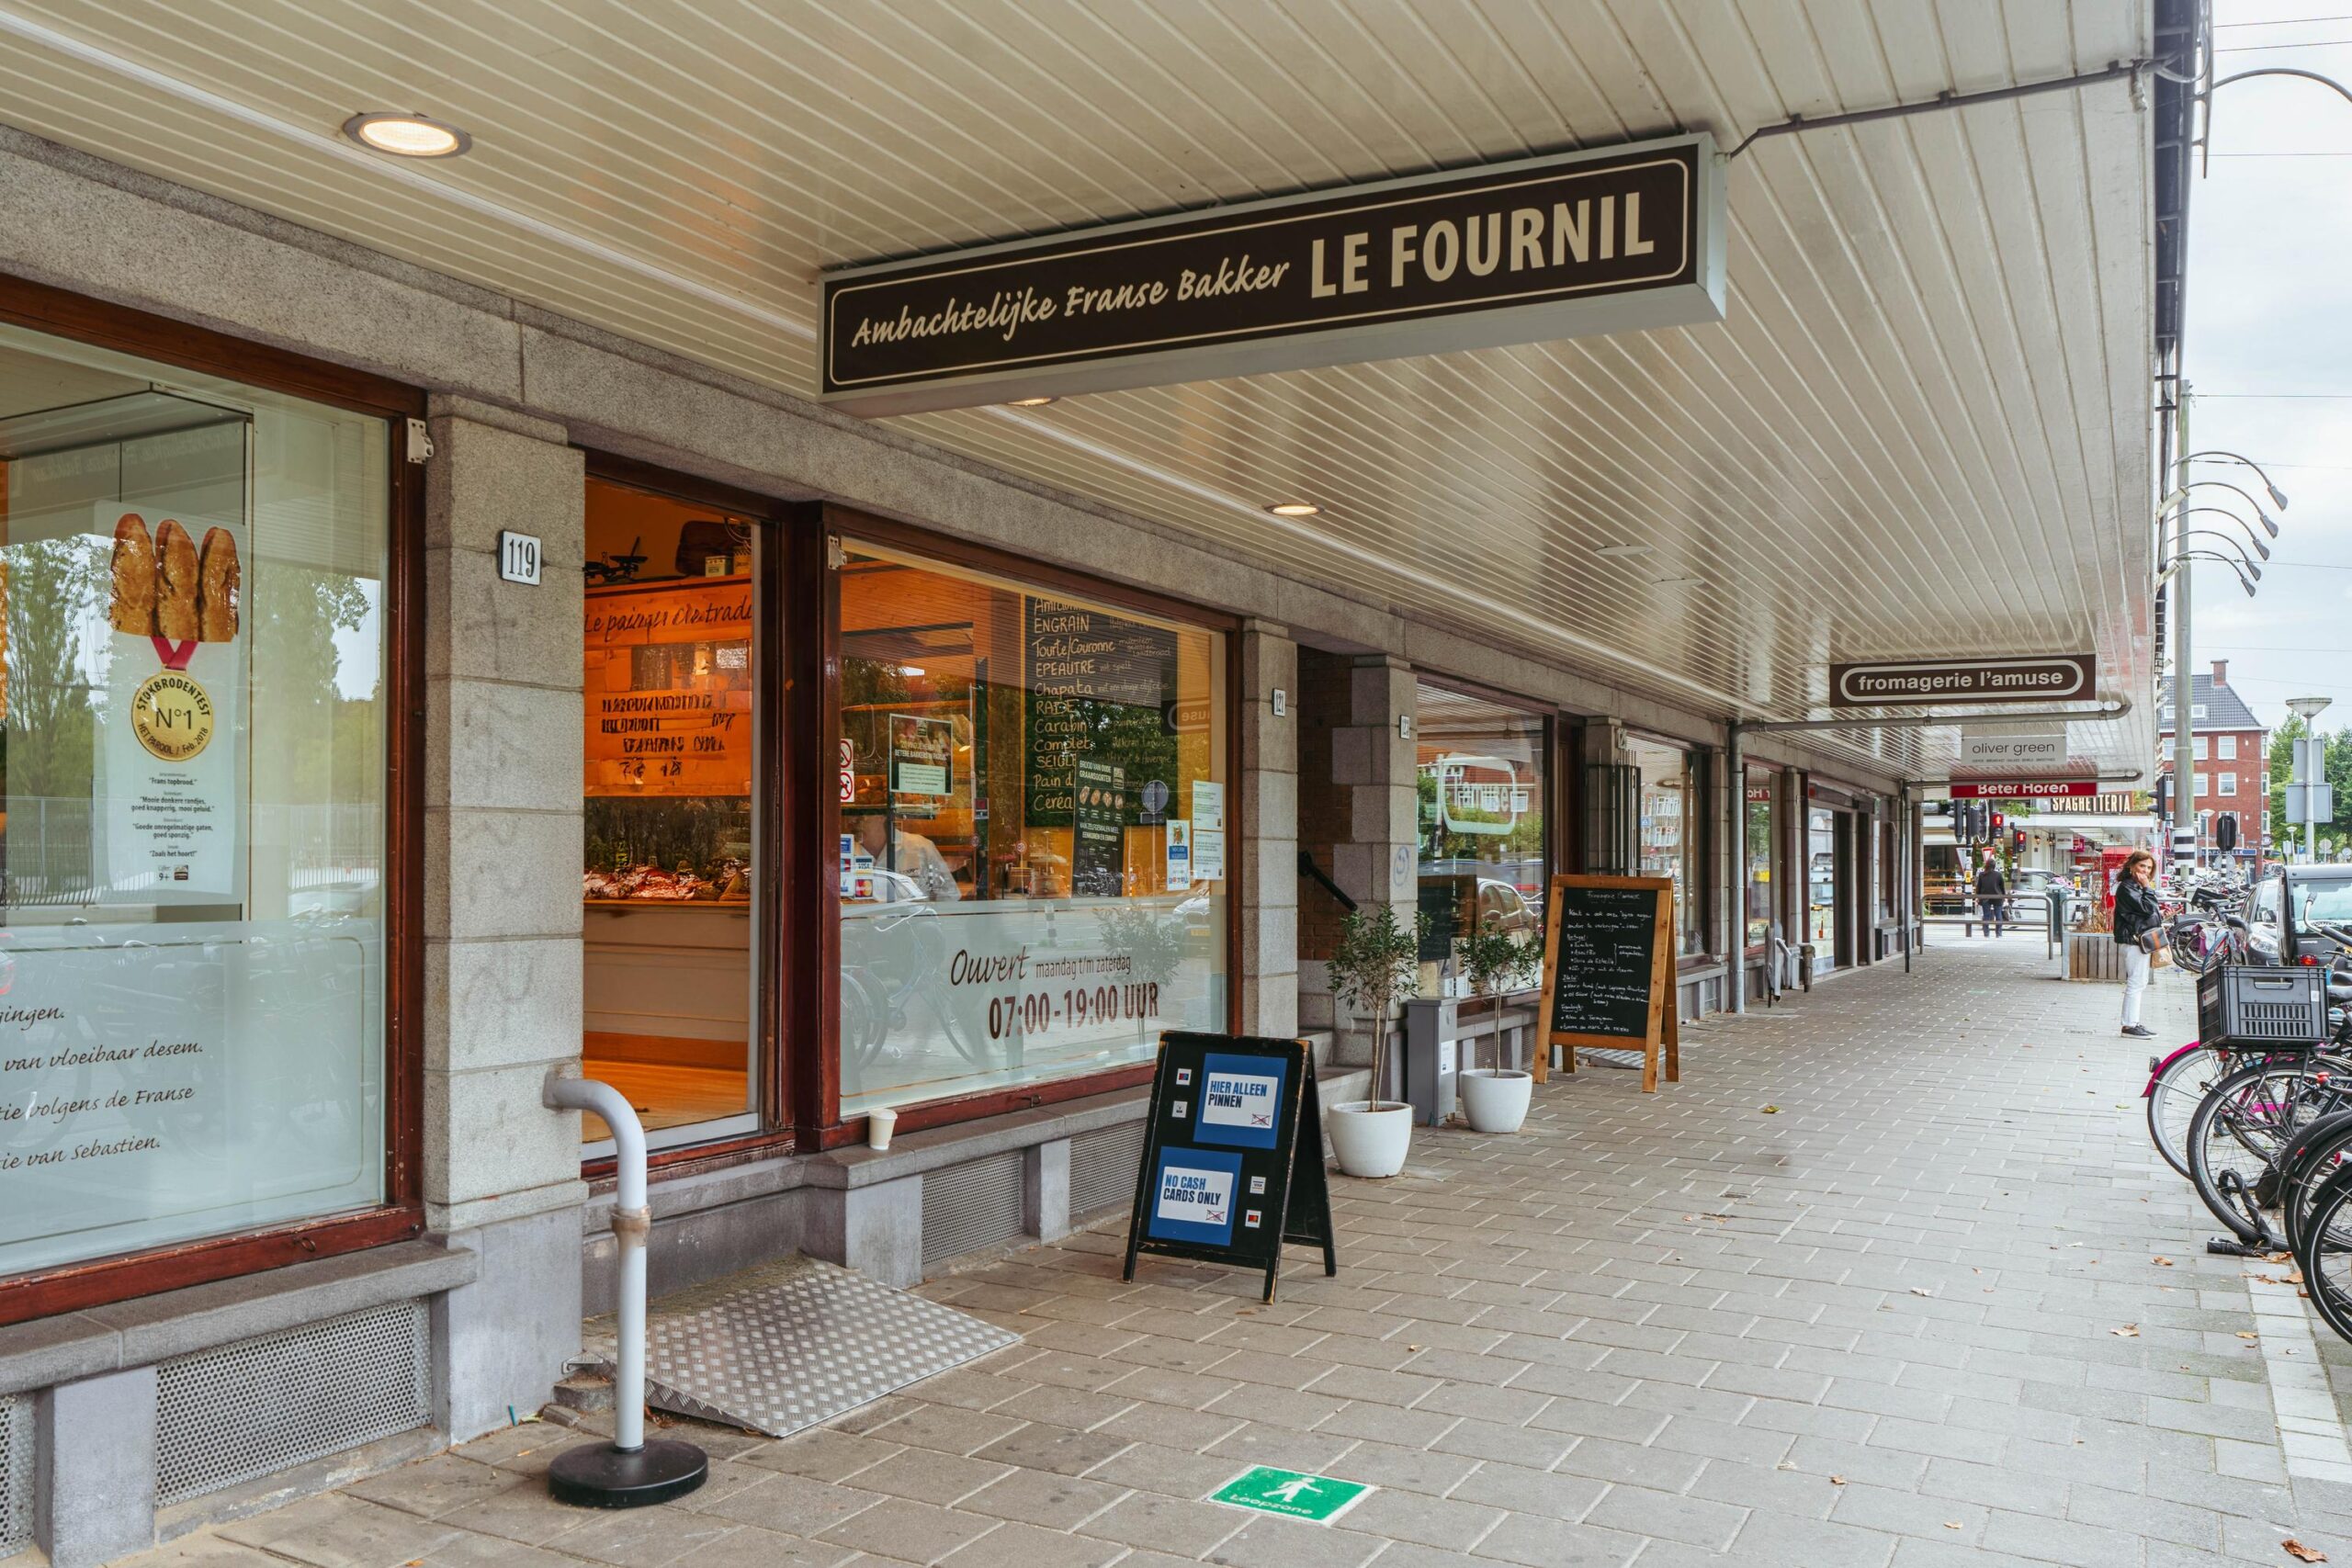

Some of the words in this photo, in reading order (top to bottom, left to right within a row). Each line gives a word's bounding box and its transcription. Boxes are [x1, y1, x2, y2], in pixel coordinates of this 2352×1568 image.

[851, 287, 1057, 349] Ambachtelijke
[1064, 276, 1170, 318] Franse
[1177, 254, 1290, 301] Bakker
[1311, 231, 1369, 299] LE
[1391, 192, 1654, 288] FOURNIL
[509, 538, 536, 578] 119
[1035, 615, 1090, 633] ENGRAIN
[1036, 660, 1095, 677] EPEAUTRE
[1035, 679, 1094, 700] Chapata
[1858, 672, 1973, 694] fromagerie
[1980, 671, 2064, 687] l'amuse
[137, 678, 210, 716] STOKBRODENTEST
[1035, 714, 1087, 734] Carabin
[194, 728, 209, 746] 2018
[1034, 734, 1091, 752] Complet
[1973, 743, 2009, 753] oliver
[2013, 743, 2054, 756] green
[1033, 773, 1061, 791] Pain
[1978, 783, 2018, 795] Beter
[2022, 782, 2069, 795] Horen
[2051, 795, 2131, 813] SPAGHETTERIA
[951, 946, 1030, 986] Ouvert
[1036, 960, 1077, 980] maandag
[1079, 958, 1094, 974] t/m
[1096, 954, 1131, 978] zaterdag
[1124, 982, 1159, 1020] UUR
[5, 1055, 46, 1072] van
[50, 1044, 139, 1067] vloeibaar
[143, 1040, 203, 1057] desem.
[1210, 1079, 1232, 1095] HIER
[1233, 1081, 1268, 1098] ALLEEN
[29, 1097, 101, 1124] volgens
[105, 1090, 130, 1108] de
[134, 1088, 196, 1105] Franse
[1207, 1093, 1242, 1109] PINNEN
[0, 1152, 24, 1169] ie
[27, 1149, 67, 1166] van
[71, 1135, 161, 1160] Sebastien.
[1165, 1174, 1179, 1188] NO
[1181, 1175, 1206, 1190] CASH
[1163, 1188, 1194, 1203] CARDS
[1197, 1190, 1221, 1206] ONLY
[1229, 1494, 1314, 1515] Loopzone
